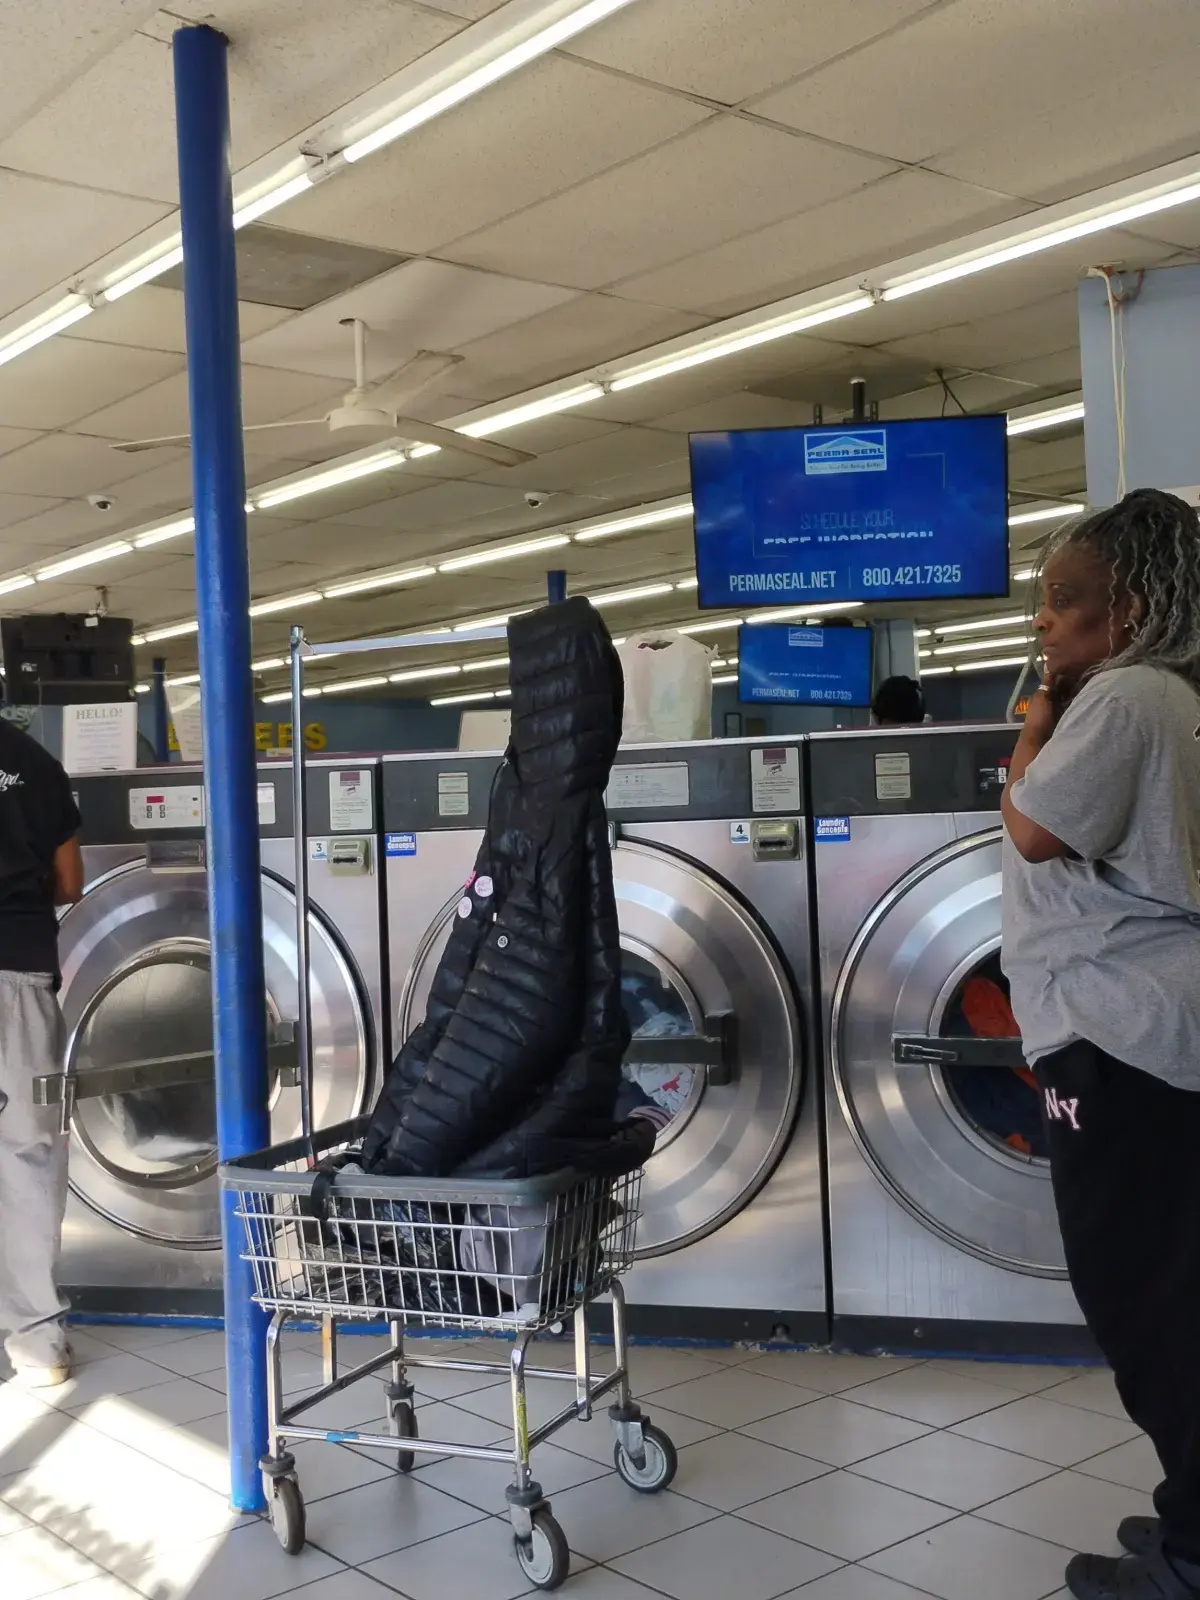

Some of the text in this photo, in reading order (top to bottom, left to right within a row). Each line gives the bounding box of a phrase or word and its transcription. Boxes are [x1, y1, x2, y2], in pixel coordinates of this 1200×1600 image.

[808, 447, 884, 457] PERMA SEAL
[863, 509, 894, 527] YOUR
[729, 570, 837, 592] PERMASEAL.NET
[862, 564, 962, 586] 800.421.7325
[76, 707, 123, 720] HELLO!
[736, 824, 744, 835] 4
[818, 819, 845, 828] Laundry
[817, 826, 849, 835] Concepts
[316, 842, 323, 852] 3
[1044, 1087, 1081, 1130] NY
